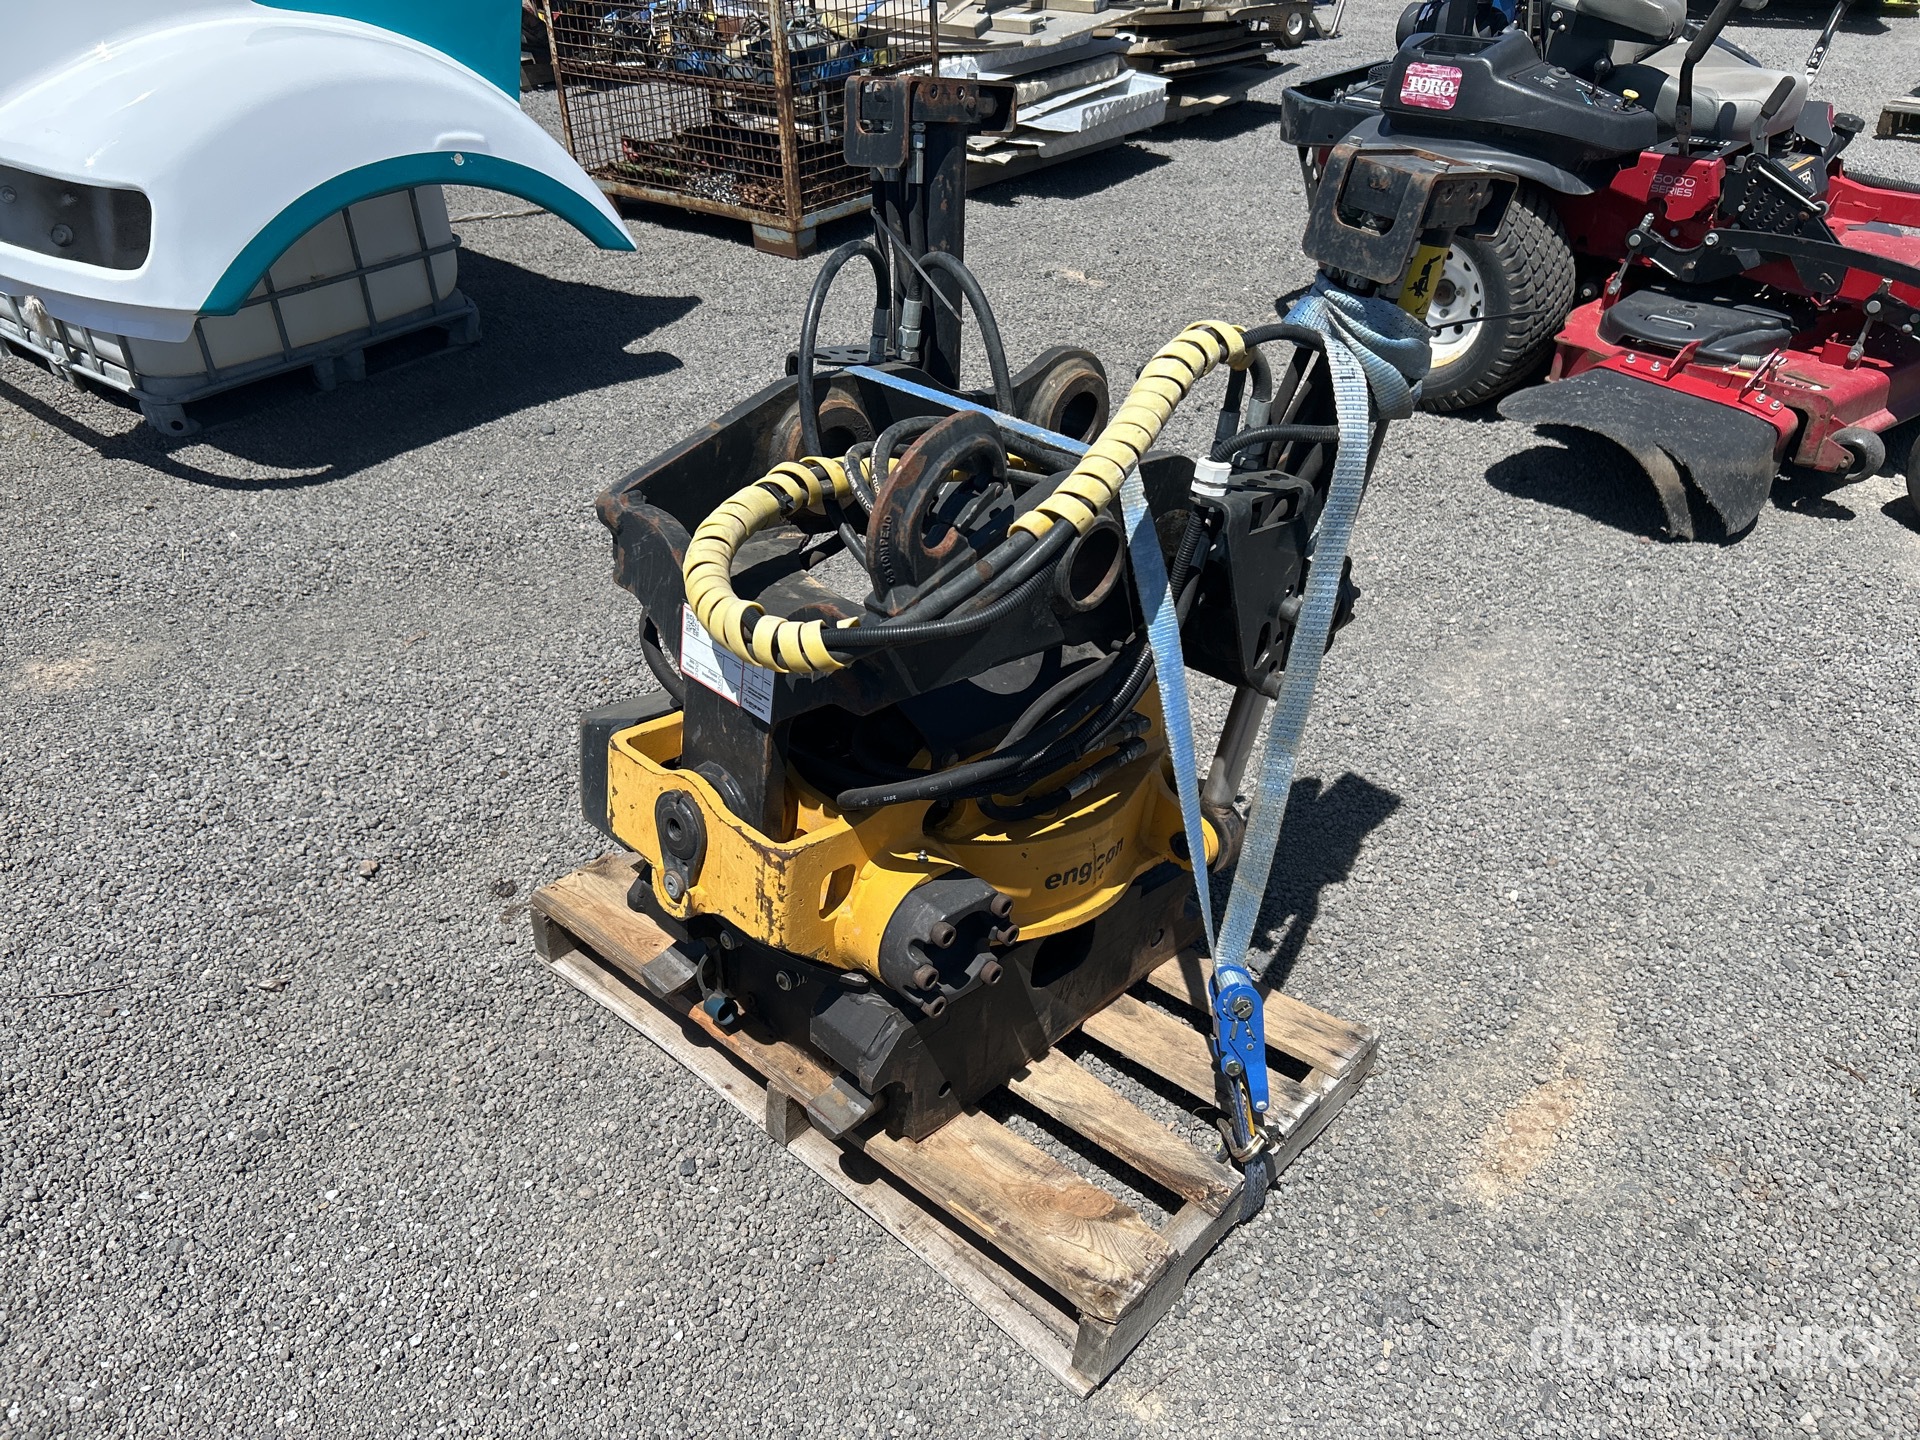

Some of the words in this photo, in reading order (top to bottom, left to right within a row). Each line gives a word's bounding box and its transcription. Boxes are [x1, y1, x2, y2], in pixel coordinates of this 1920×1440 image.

[1408, 76, 1454, 97] TORO
[1653, 173, 1696, 188] 6000
[1650, 184, 1693, 198] SERIES
[1044, 837, 1124, 890] engcon
